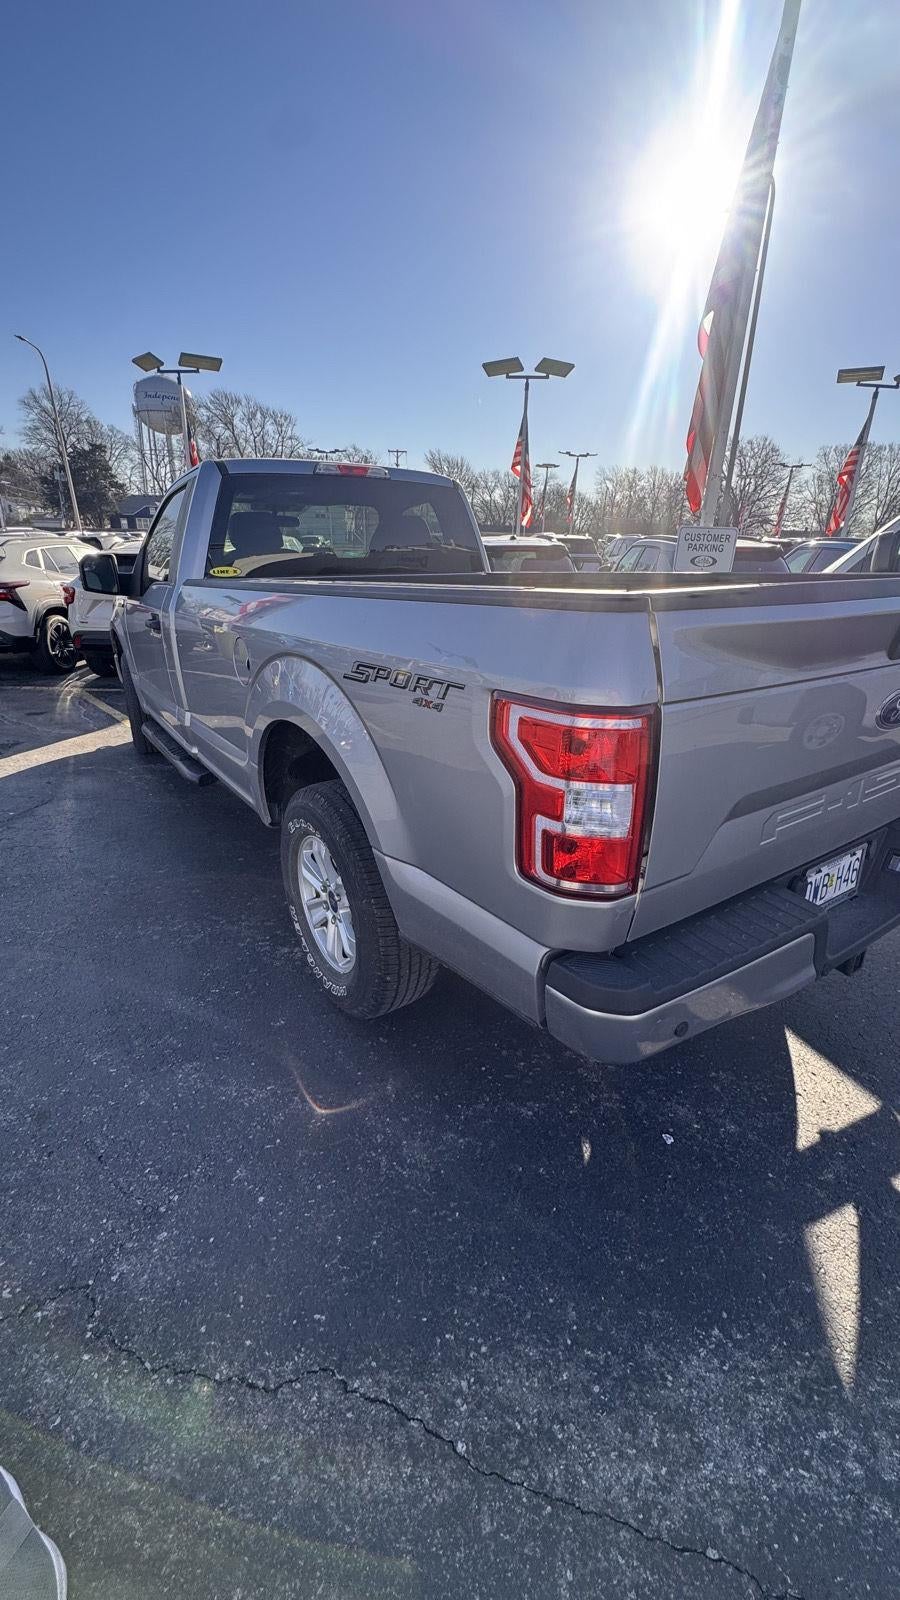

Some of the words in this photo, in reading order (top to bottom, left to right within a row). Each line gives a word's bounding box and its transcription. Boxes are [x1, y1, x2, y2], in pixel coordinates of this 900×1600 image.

[143, 391, 180, 401] Indepen
[684, 532, 731, 543] CUSTOMER
[687, 542, 725, 553] PARKING
[342, 660, 466, 700] SPORT
